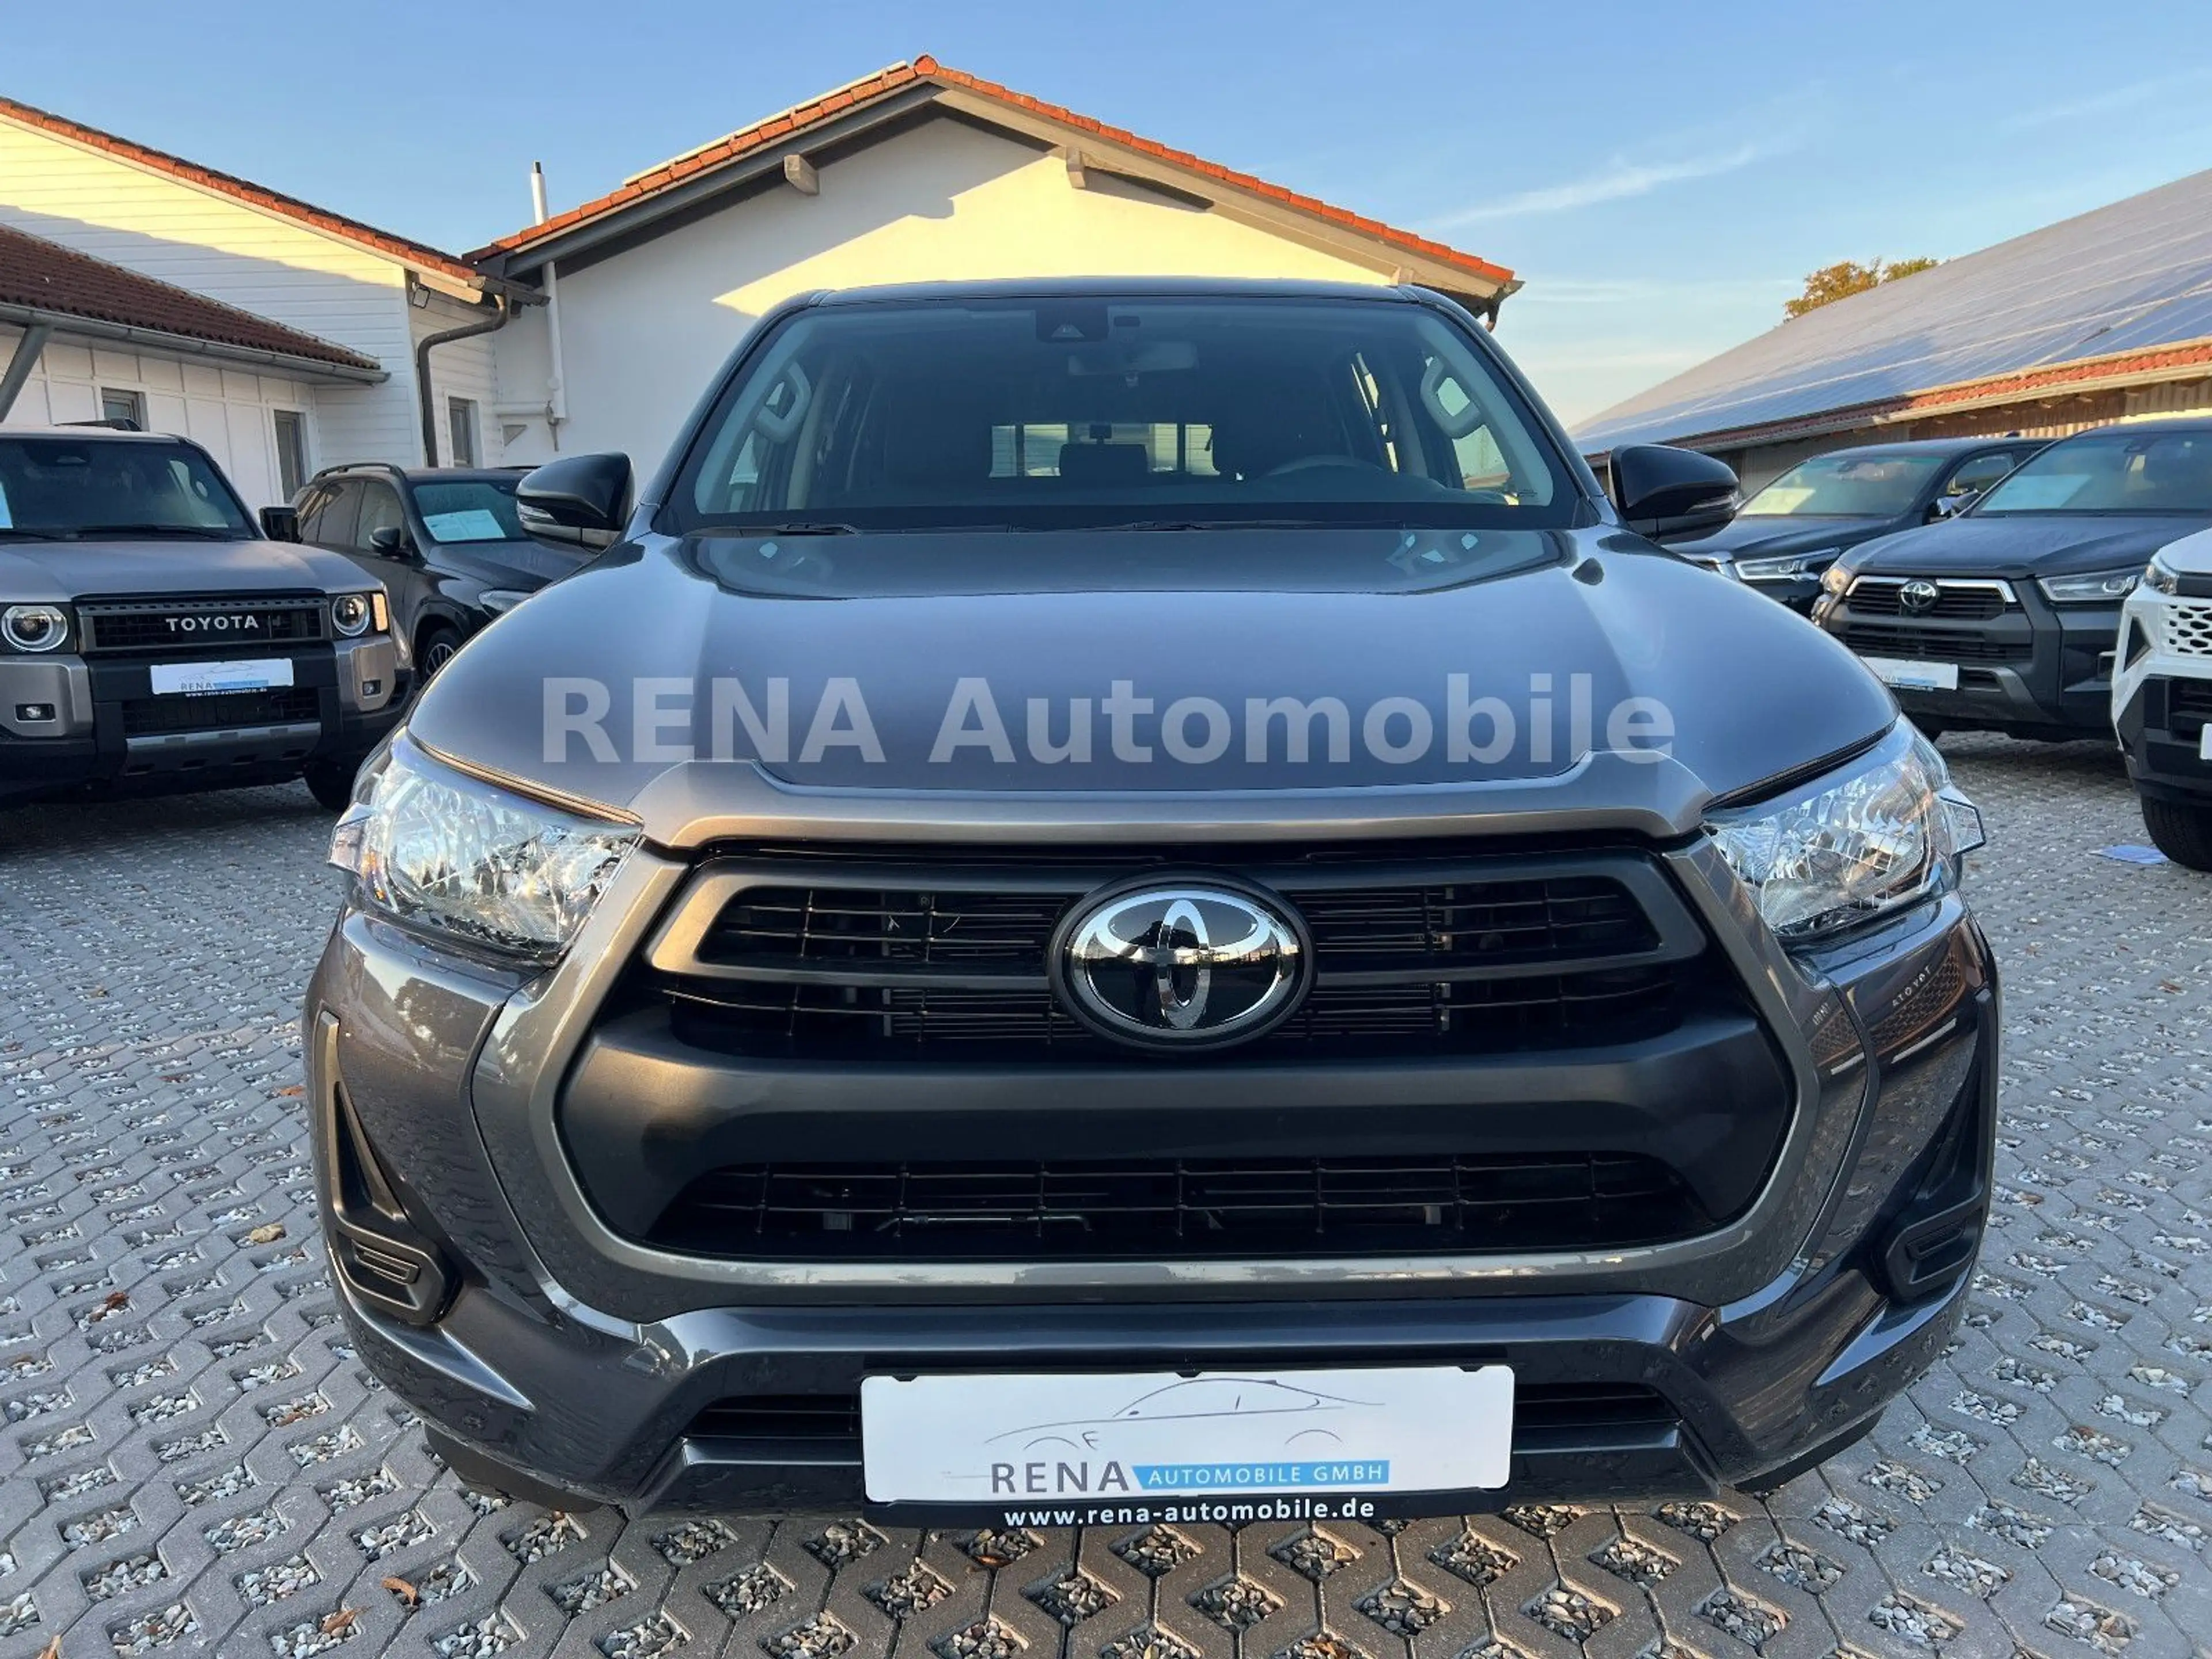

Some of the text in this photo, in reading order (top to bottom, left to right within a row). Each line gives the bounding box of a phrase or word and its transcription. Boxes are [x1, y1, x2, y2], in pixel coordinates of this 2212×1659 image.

[165, 615, 259, 631] TOYOTA
[991, 1461, 1382, 1493] RENA AUTOMOBILE GMBH
[1004, 1497, 1374, 1527] www.rena-automobile.de
